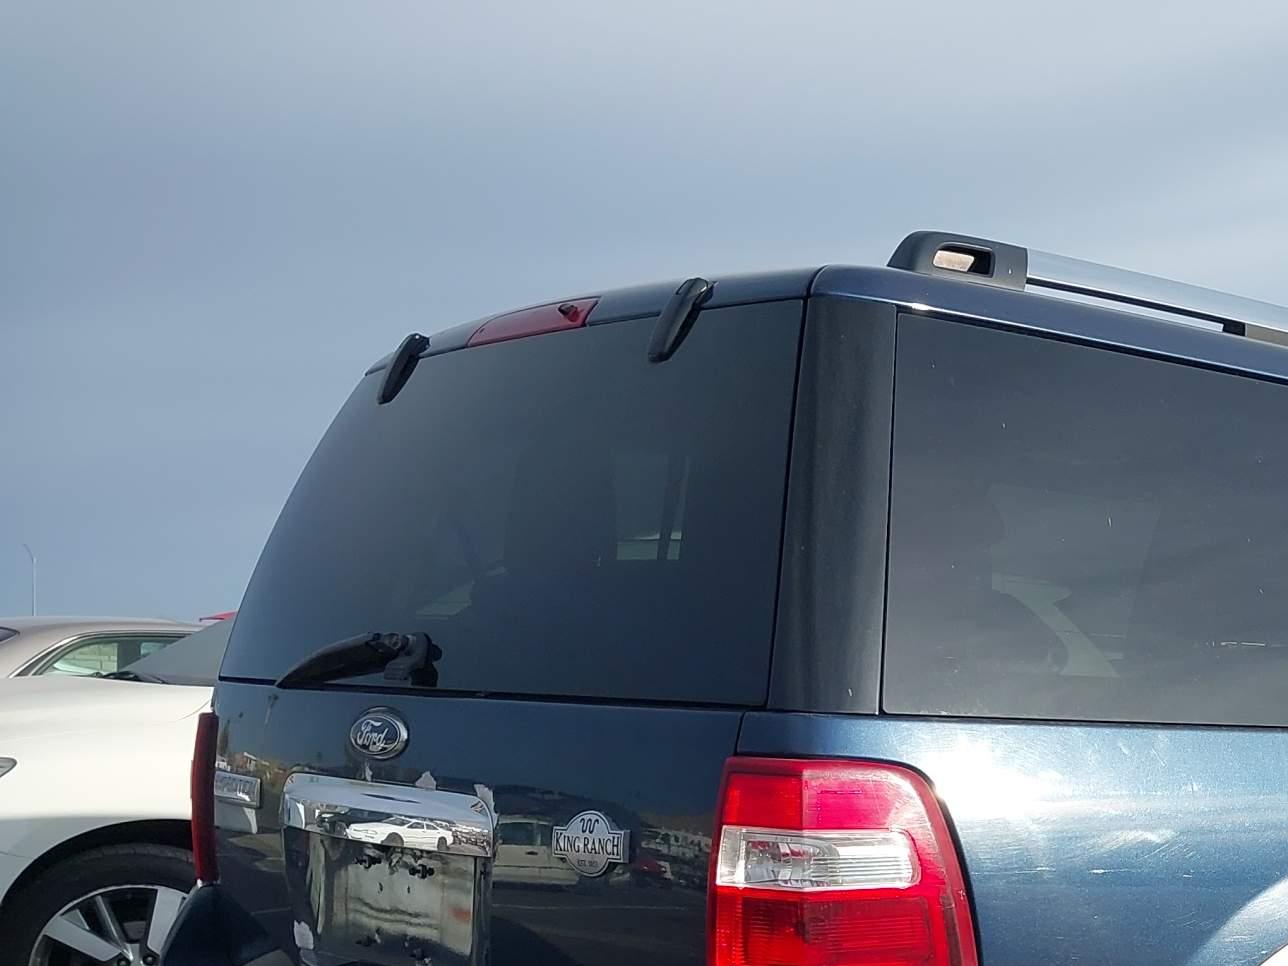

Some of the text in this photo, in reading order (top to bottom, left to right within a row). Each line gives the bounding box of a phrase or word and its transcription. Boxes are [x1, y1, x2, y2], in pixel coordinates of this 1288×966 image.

[356, 719, 397, 752] Ford
[555, 831, 620, 857] KING RANCH
